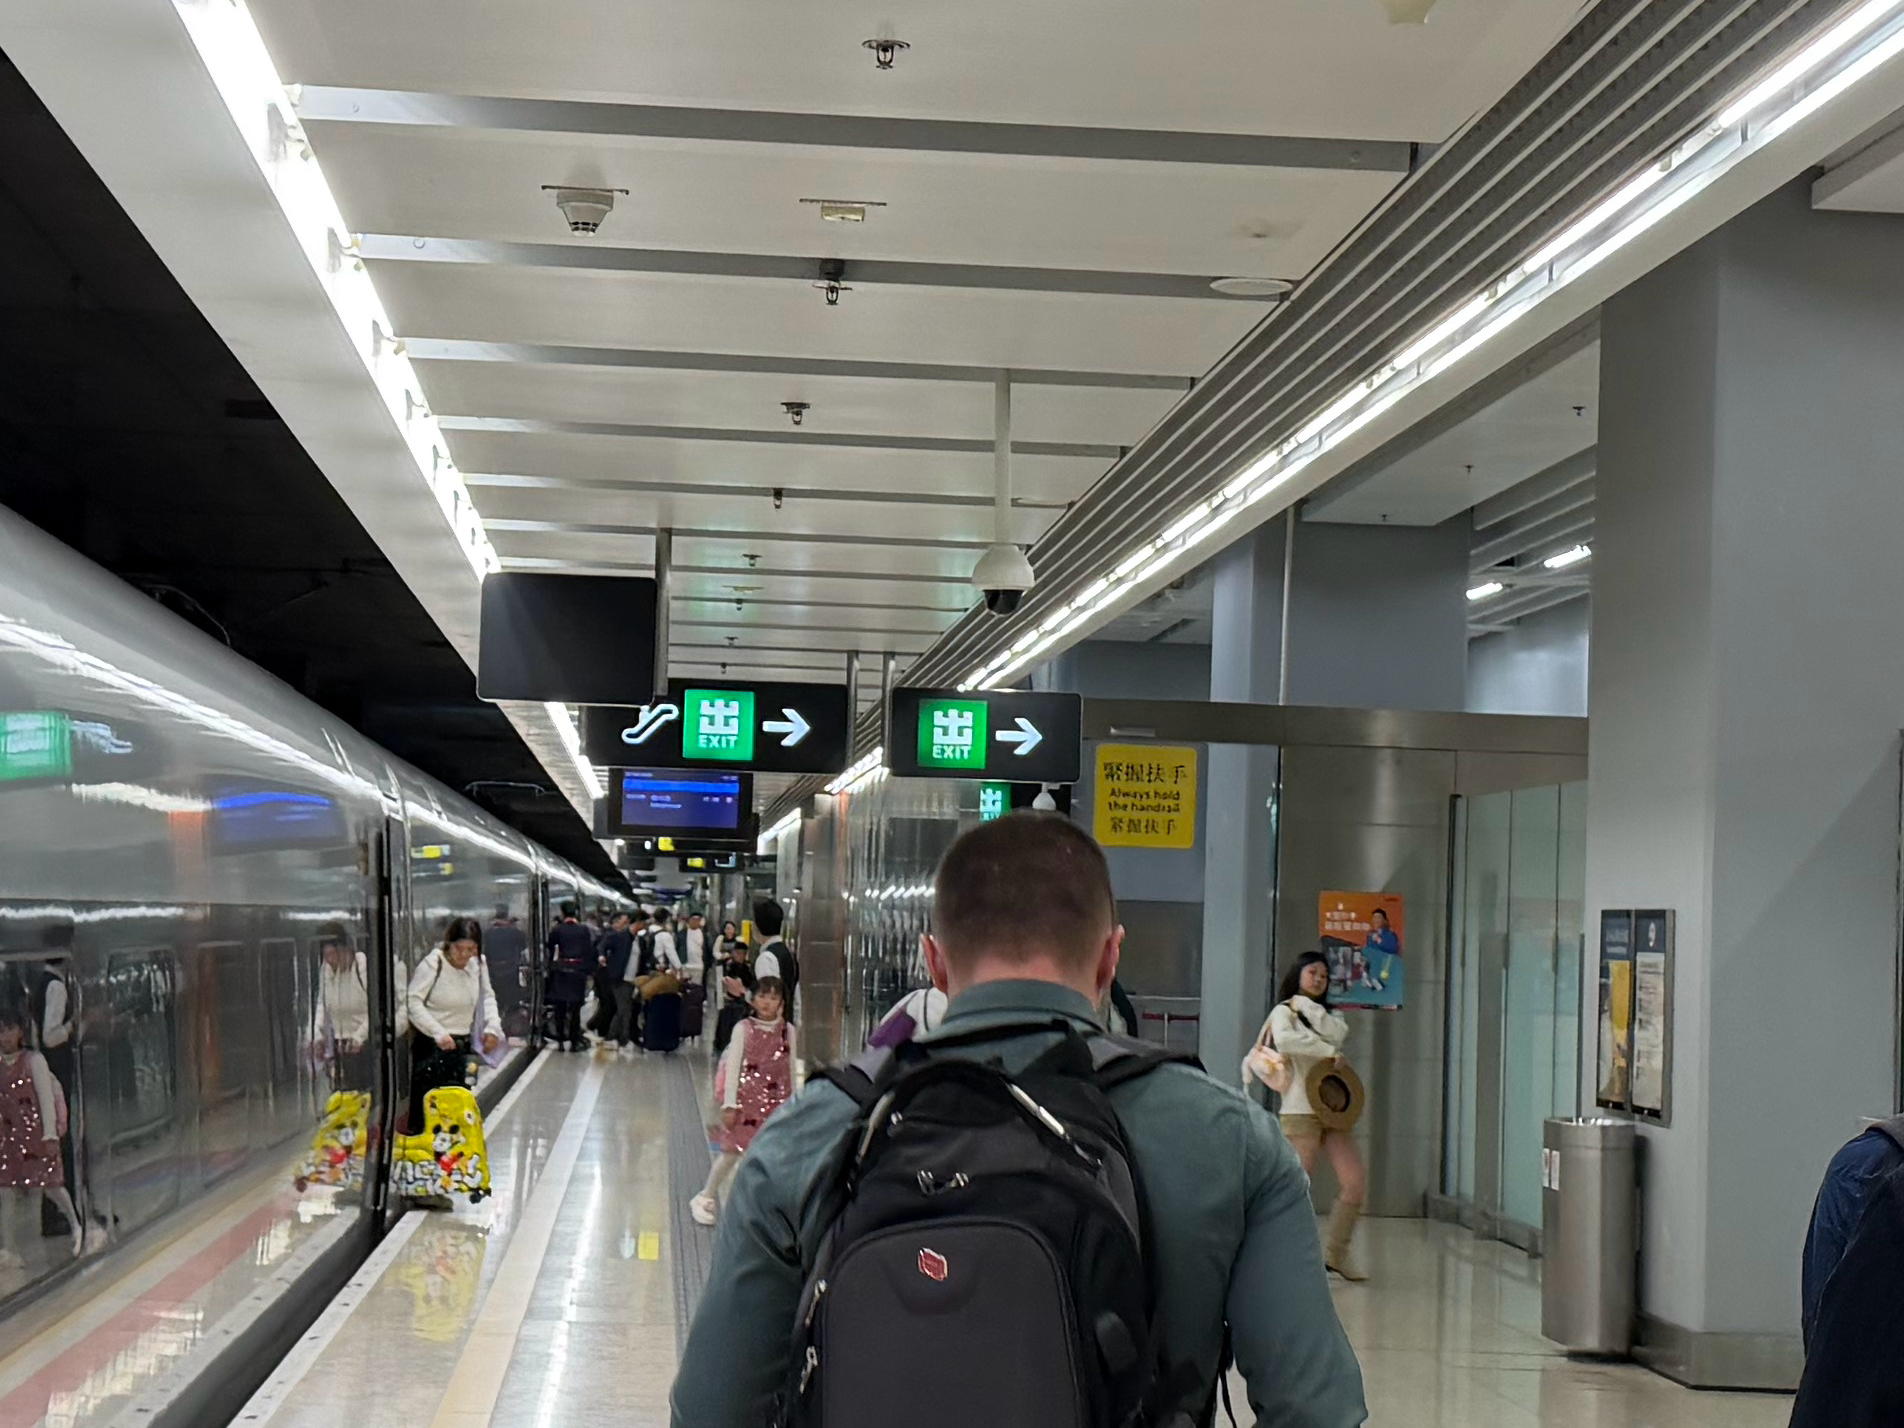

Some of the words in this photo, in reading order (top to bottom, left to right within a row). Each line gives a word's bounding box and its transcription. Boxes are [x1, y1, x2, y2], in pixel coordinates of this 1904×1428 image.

[699, 698, 739, 734] 出
[933, 708, 973, 745] 出
[698, 734, 739, 749] EXIT
[932, 744, 973, 760] EXIT
[1109, 787, 1151, 802] Always
[1154, 790, 1181, 801] hold
[1108, 800, 1129, 812] the
